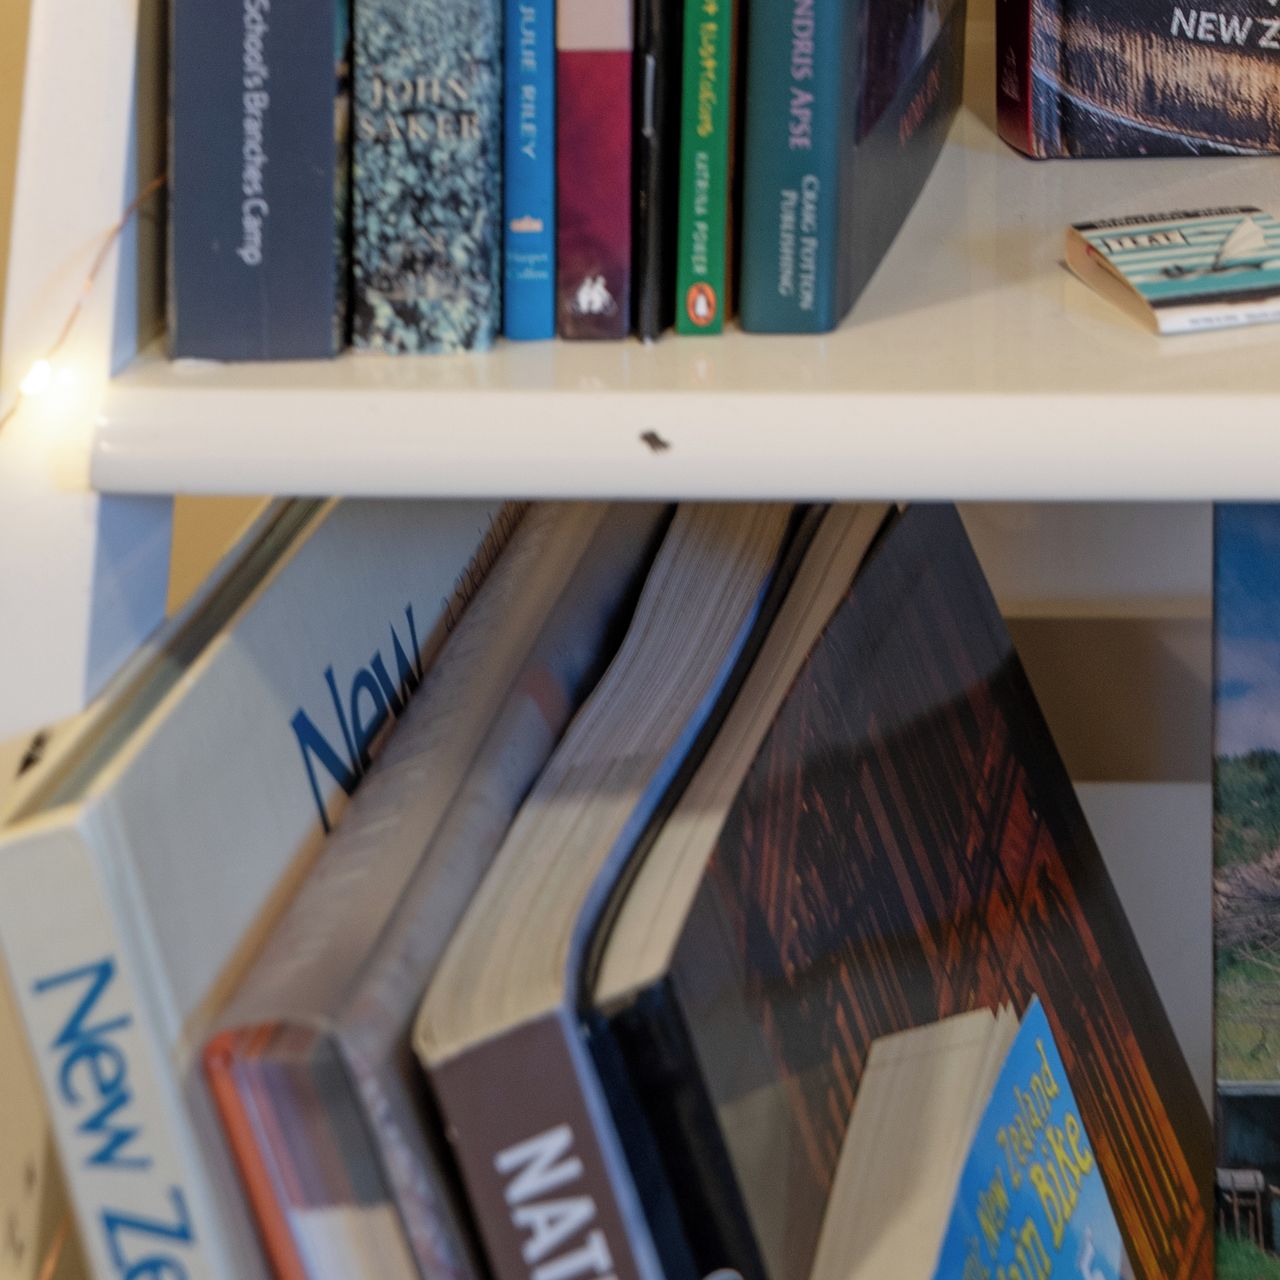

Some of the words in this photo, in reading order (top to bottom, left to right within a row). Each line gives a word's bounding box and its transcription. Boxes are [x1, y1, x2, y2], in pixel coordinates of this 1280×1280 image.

[518, 4, 538, 73] JULIE
[1169, 6, 1253, 44] NEW
[241, 90, 271, 196] Branches
[361, 111, 481, 141] SAKER
[519, 83, 538, 160] RILEY
[788, 86, 815, 151] APSE
[236, 197, 272, 267] Camp
[31, 955, 154, 1171] New
[492, 1122, 618, 1280] NAT
